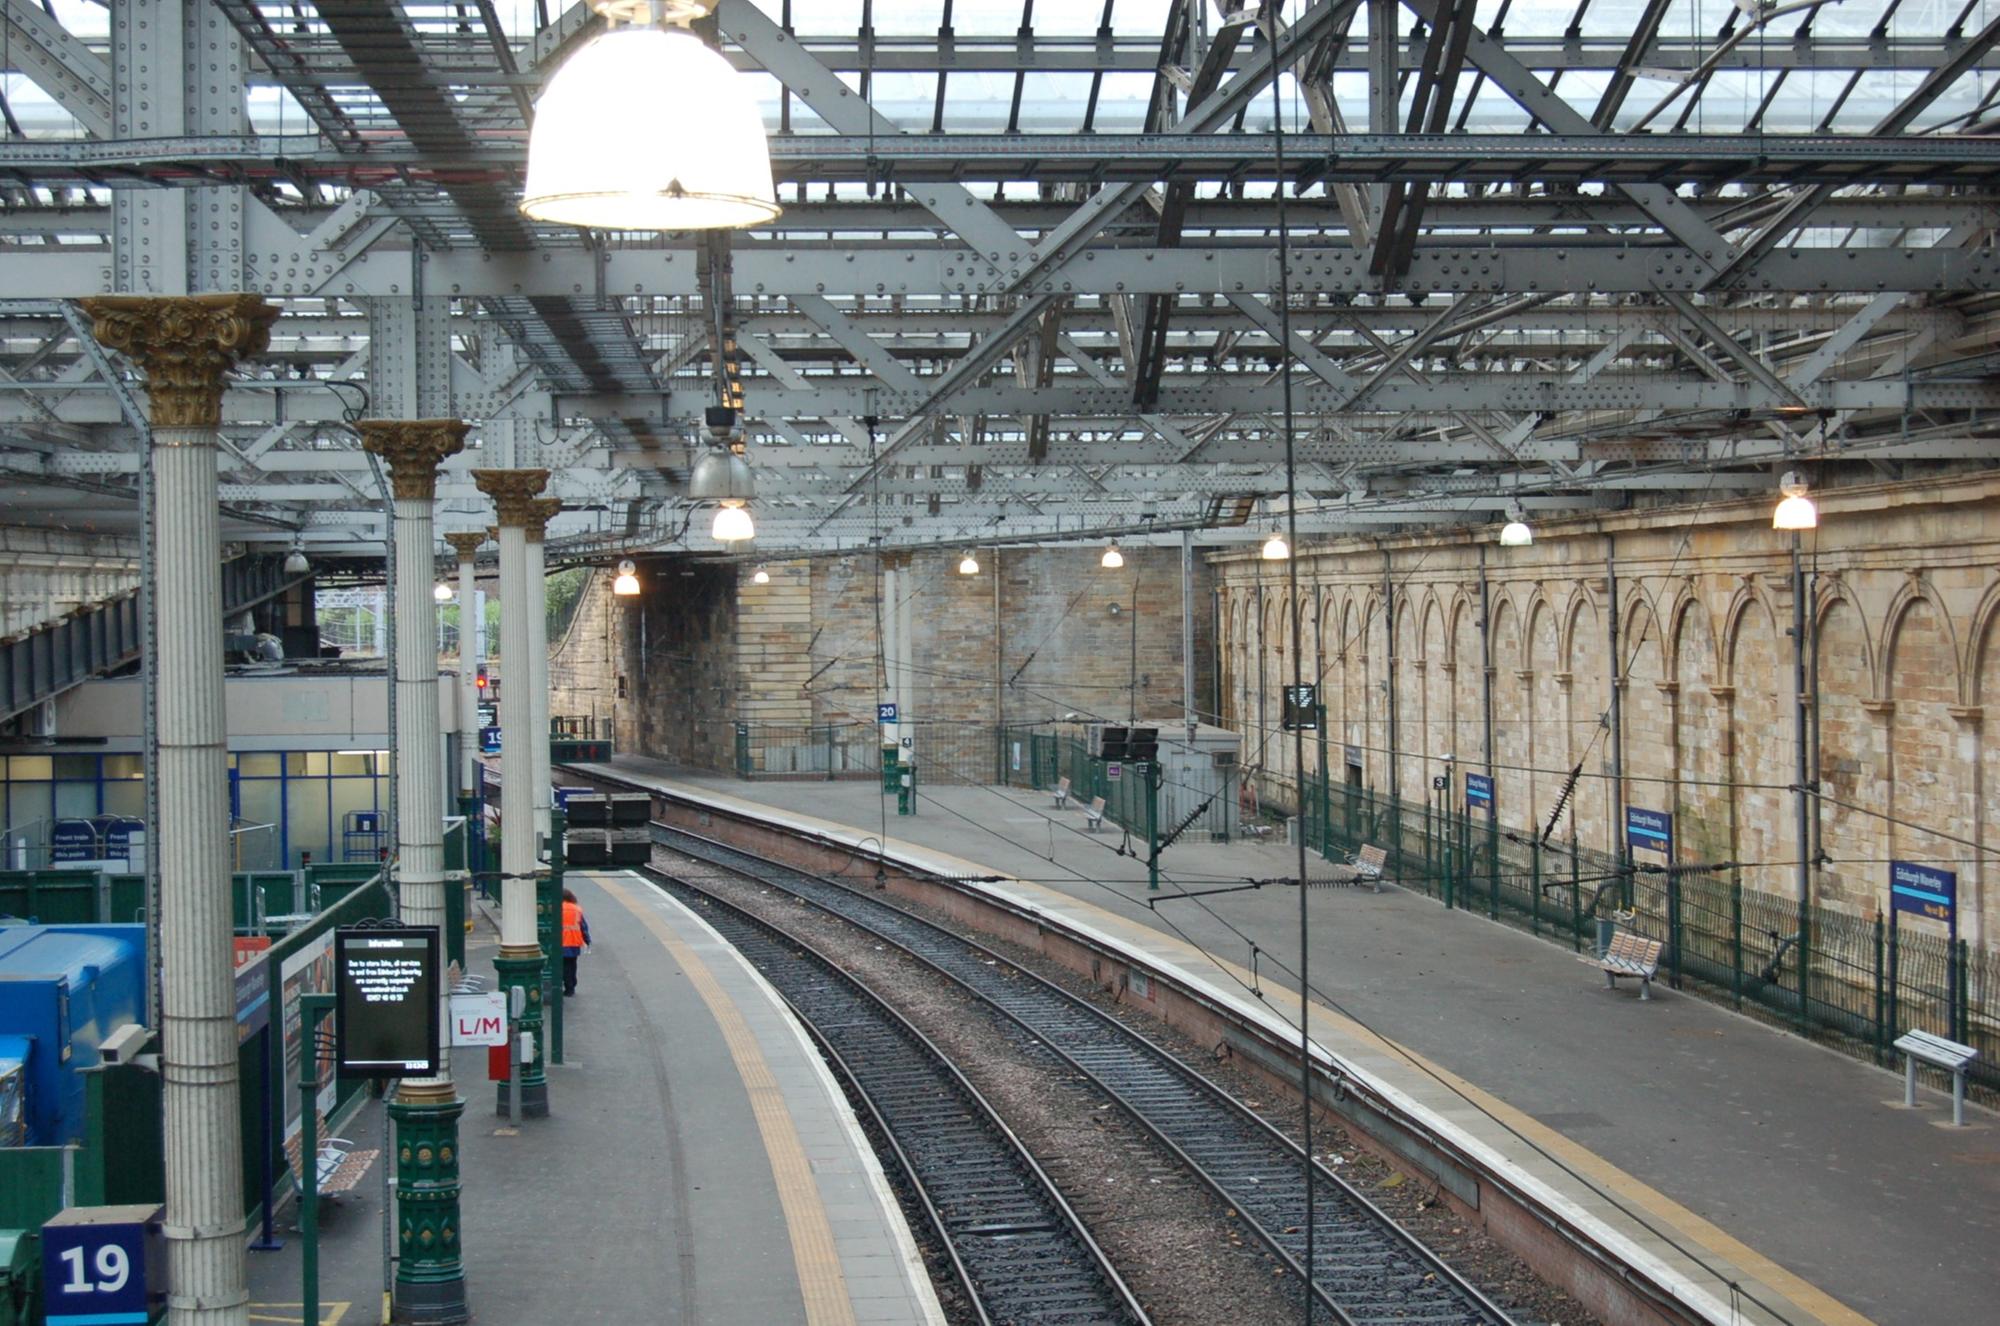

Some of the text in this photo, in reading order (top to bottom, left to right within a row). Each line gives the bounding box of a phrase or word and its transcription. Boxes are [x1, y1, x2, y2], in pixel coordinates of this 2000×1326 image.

[880, 706, 895, 717] 20
[1436, 777, 1444, 787] 3
[1896, 867, 1942, 892] Edinburgh Waverley
[368, 939, 404, 948] Information
[459, 1017, 501, 1035] L/M
[61, 1244, 130, 1293] 19
